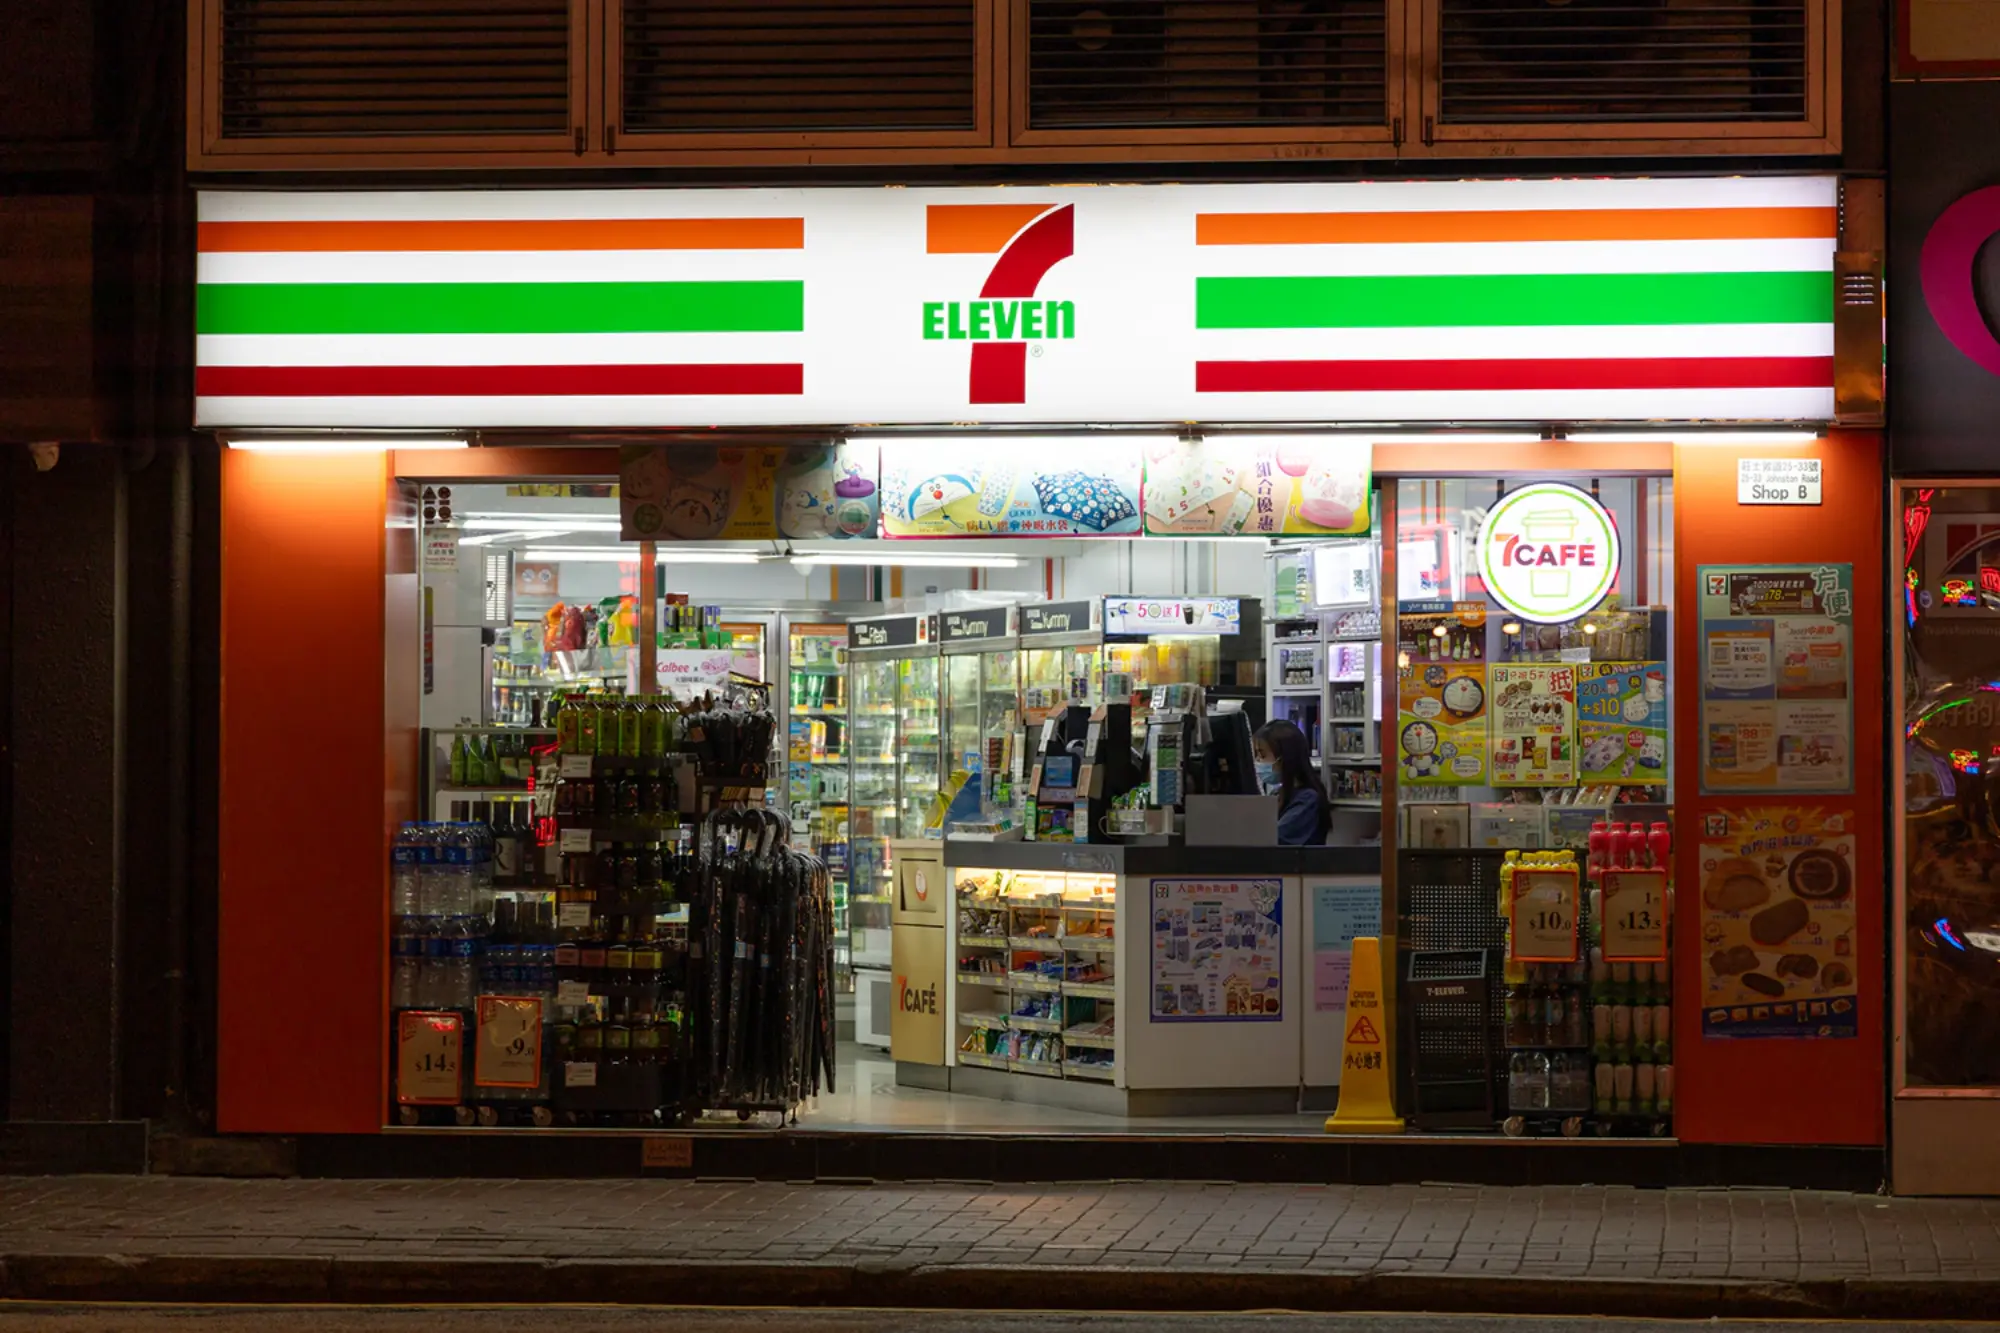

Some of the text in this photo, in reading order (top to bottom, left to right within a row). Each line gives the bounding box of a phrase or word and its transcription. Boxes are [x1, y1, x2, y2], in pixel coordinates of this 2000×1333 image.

[926, 203, 1074, 404] 7
[1766, 473, 1799, 483] Johnston
[1801, 473, 1819, 483] Road
[1752, 484, 1808, 500] Shop B
[656, 661, 690, 673] Calbee
[1529, 911, 1571, 930] $10.0
[1619, 911, 1661, 931] $13.5
[1353, 990, 1376, 999] CAUTION
[1350, 1000, 1378, 1009] WET FLOOR
[505, 1038, 535, 1057] $9.0
[415, 1053, 456, 1072] $14.5
[1345, 1051, 1381, 1070] 小心地滑
